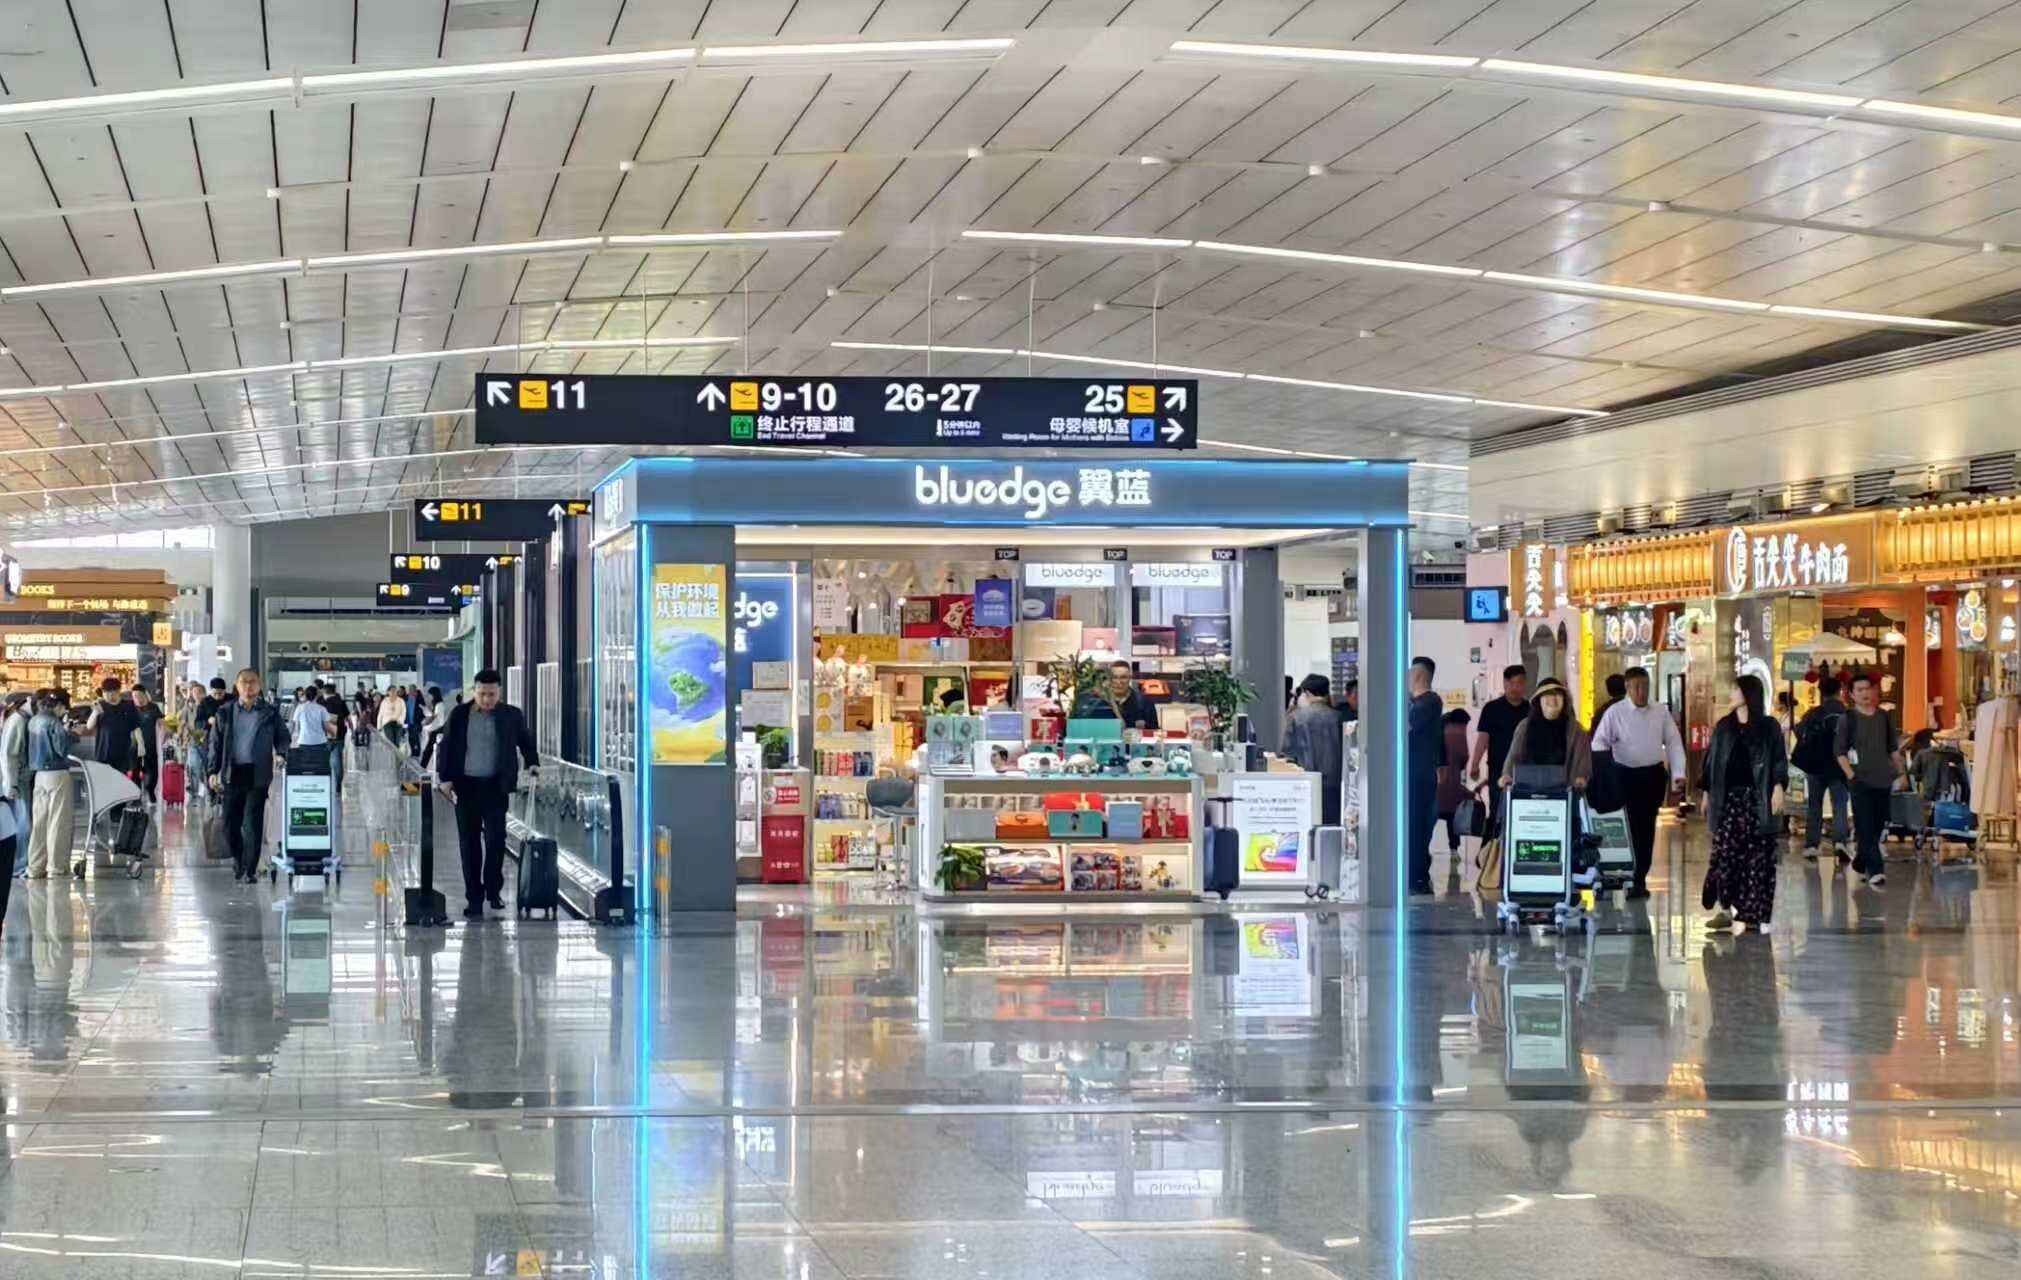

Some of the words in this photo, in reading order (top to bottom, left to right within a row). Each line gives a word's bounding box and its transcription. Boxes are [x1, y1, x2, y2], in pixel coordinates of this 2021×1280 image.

[551, 380, 585, 410] 11
[762, 382, 837, 411] 9-10
[884, 383, 981, 412] 26-27
[1084, 385, 1124, 413] 25
[757, 415, 855, 432] 终止行程通道
[1050, 417, 1130, 433] 母婴候机室
[915, 464, 1072, 519] bluedge
[1079, 468, 1152, 506] 翼蓝
[461, 503, 482, 520] 11
[423, 555, 441, 570] 10
[998, 550, 1017, 559] TOP
[1215, 550, 1233, 560] TOP
[1041, 564, 1103, 582] bluedge
[1148, 564, 1209, 583] bluedge
[401, 584, 411, 596] 9
